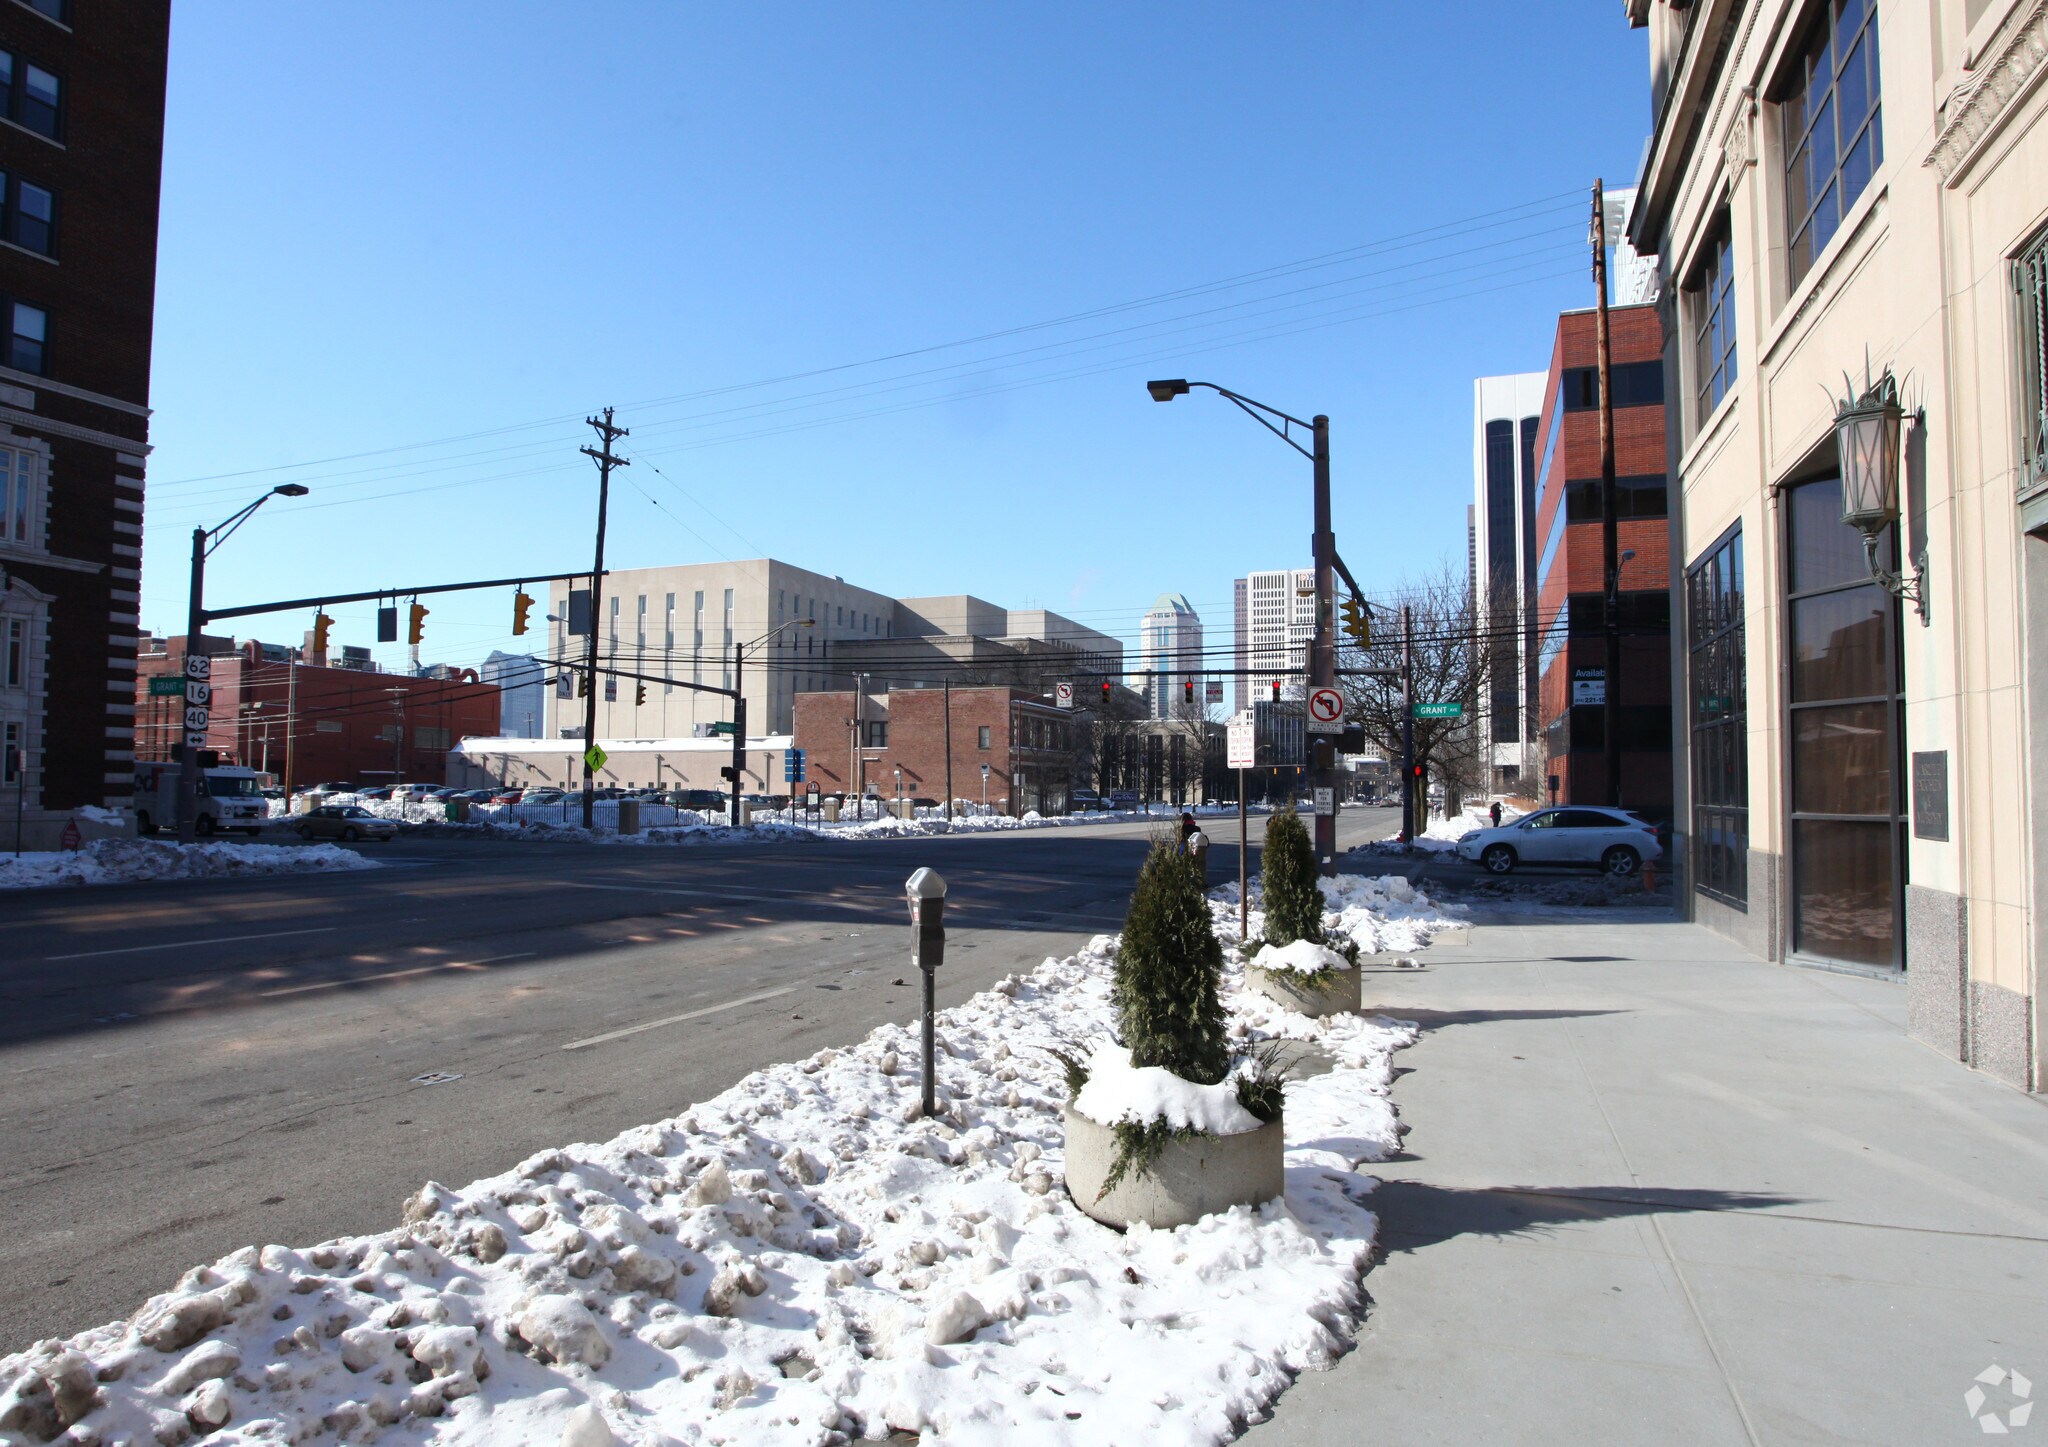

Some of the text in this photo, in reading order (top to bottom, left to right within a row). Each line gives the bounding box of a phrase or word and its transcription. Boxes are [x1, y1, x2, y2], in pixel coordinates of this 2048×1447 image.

[189, 660, 208, 673] 62
[156, 681, 178, 692] GRANT
[190, 686, 207, 699] 16
[1420, 706, 1447, 715] GRANT
[187, 712, 206, 725] 40
